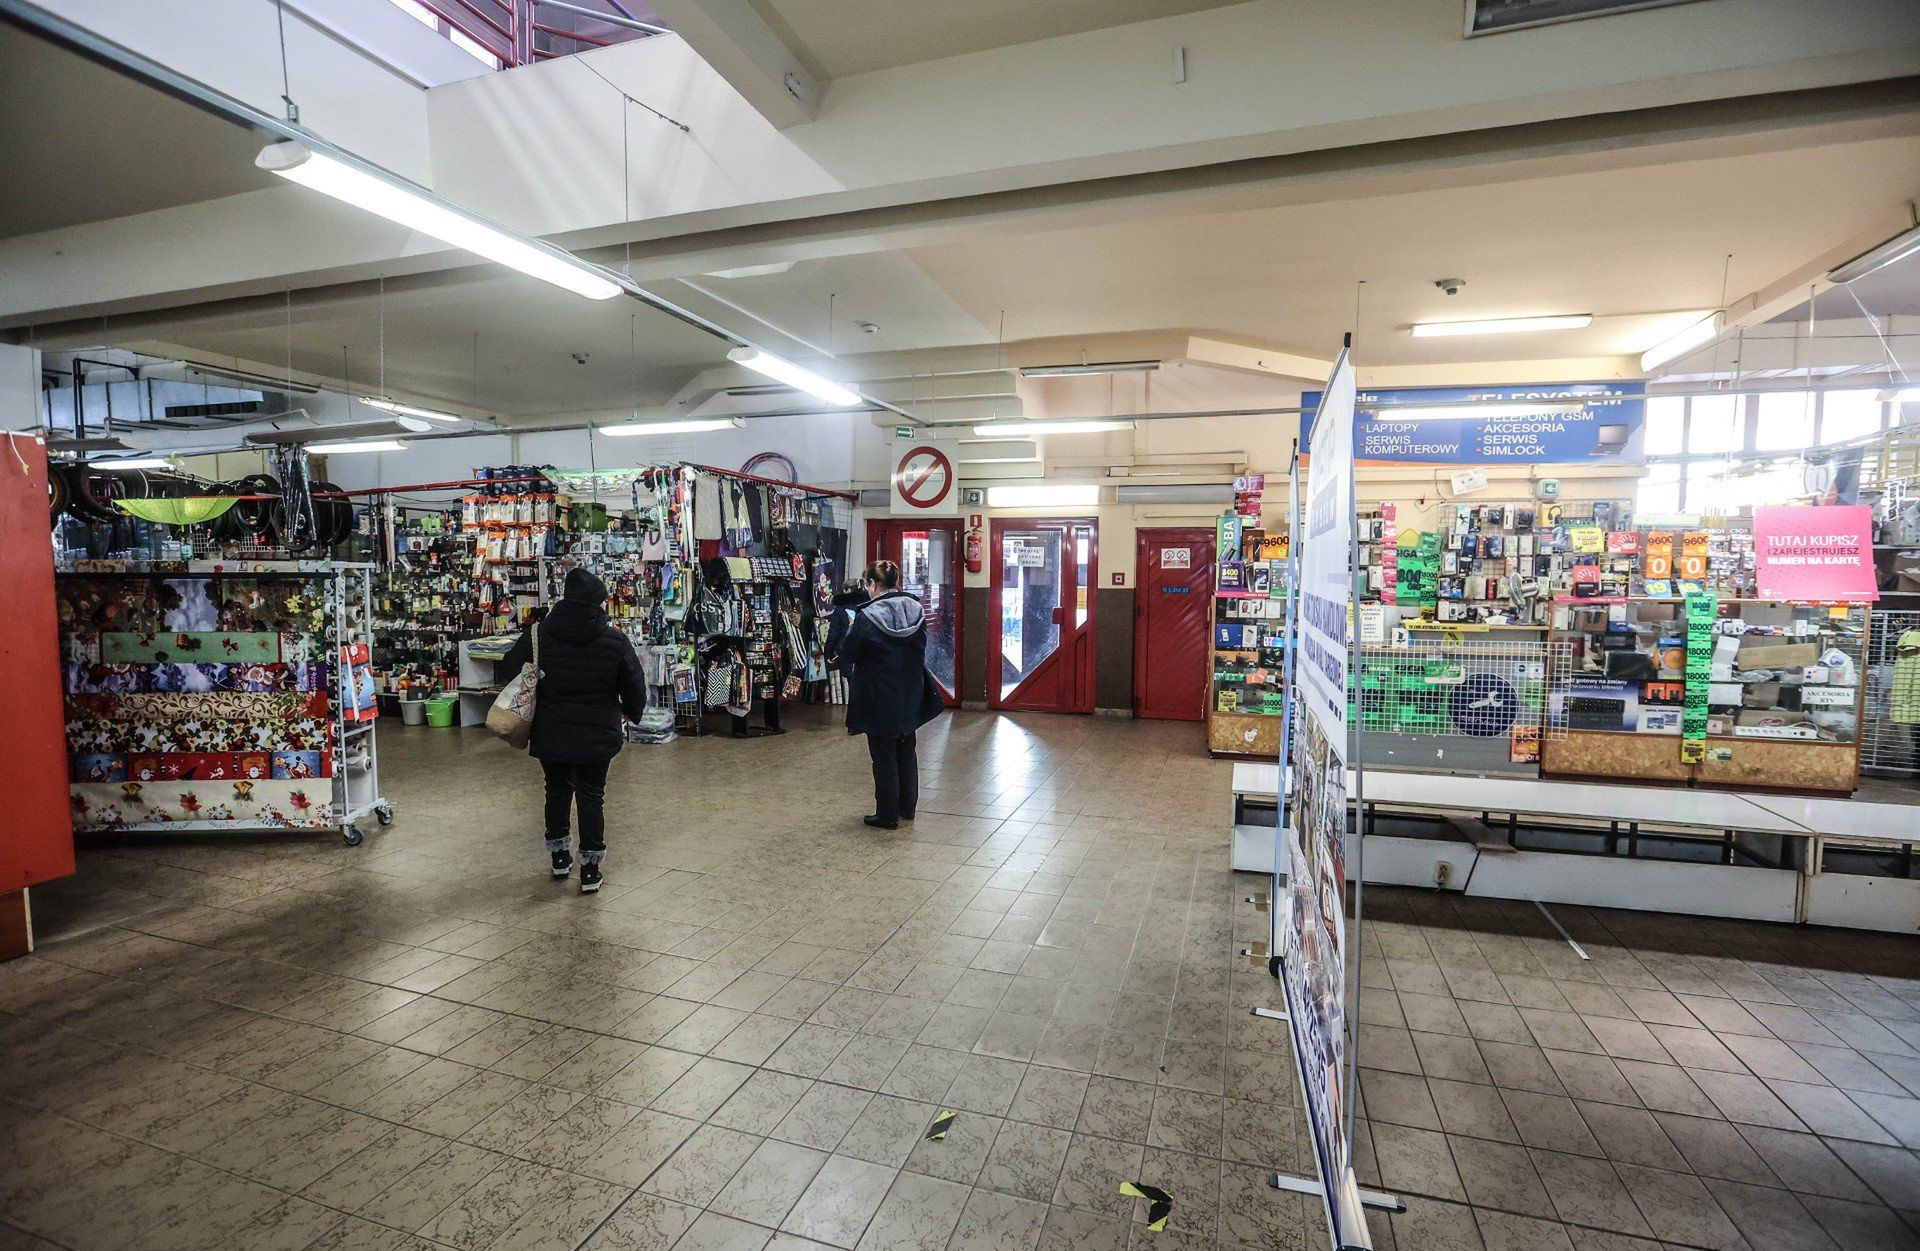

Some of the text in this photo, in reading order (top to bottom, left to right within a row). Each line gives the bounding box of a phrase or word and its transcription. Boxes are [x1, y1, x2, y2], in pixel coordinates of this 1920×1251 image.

[1561, 411, 1594, 421] GSM
[1365, 423, 1420, 433] LAPTOPY
[1483, 423, 1566, 434] AKCESORIA
[1365, 435, 1411, 445] SERWIS
[1483, 434, 1538, 444] SERWIS
[1365, 444, 1460, 454] KOMPUTEROWY
[1483, 445, 1546, 455] SIMLOCK
[1264, 536, 1290, 548] 9600
[1767, 535, 1859, 546] TUTAJ KUPISZ
[1652, 558, 1667, 574] 0
[1686, 558, 1701, 574] 0
[1767, 557, 1860, 566] NUMER NA KARTĘ
[1689, 623, 1711, 631] 18000
[1688, 648, 1711, 656] 18000
[1686, 673, 1710, 681] 18000
